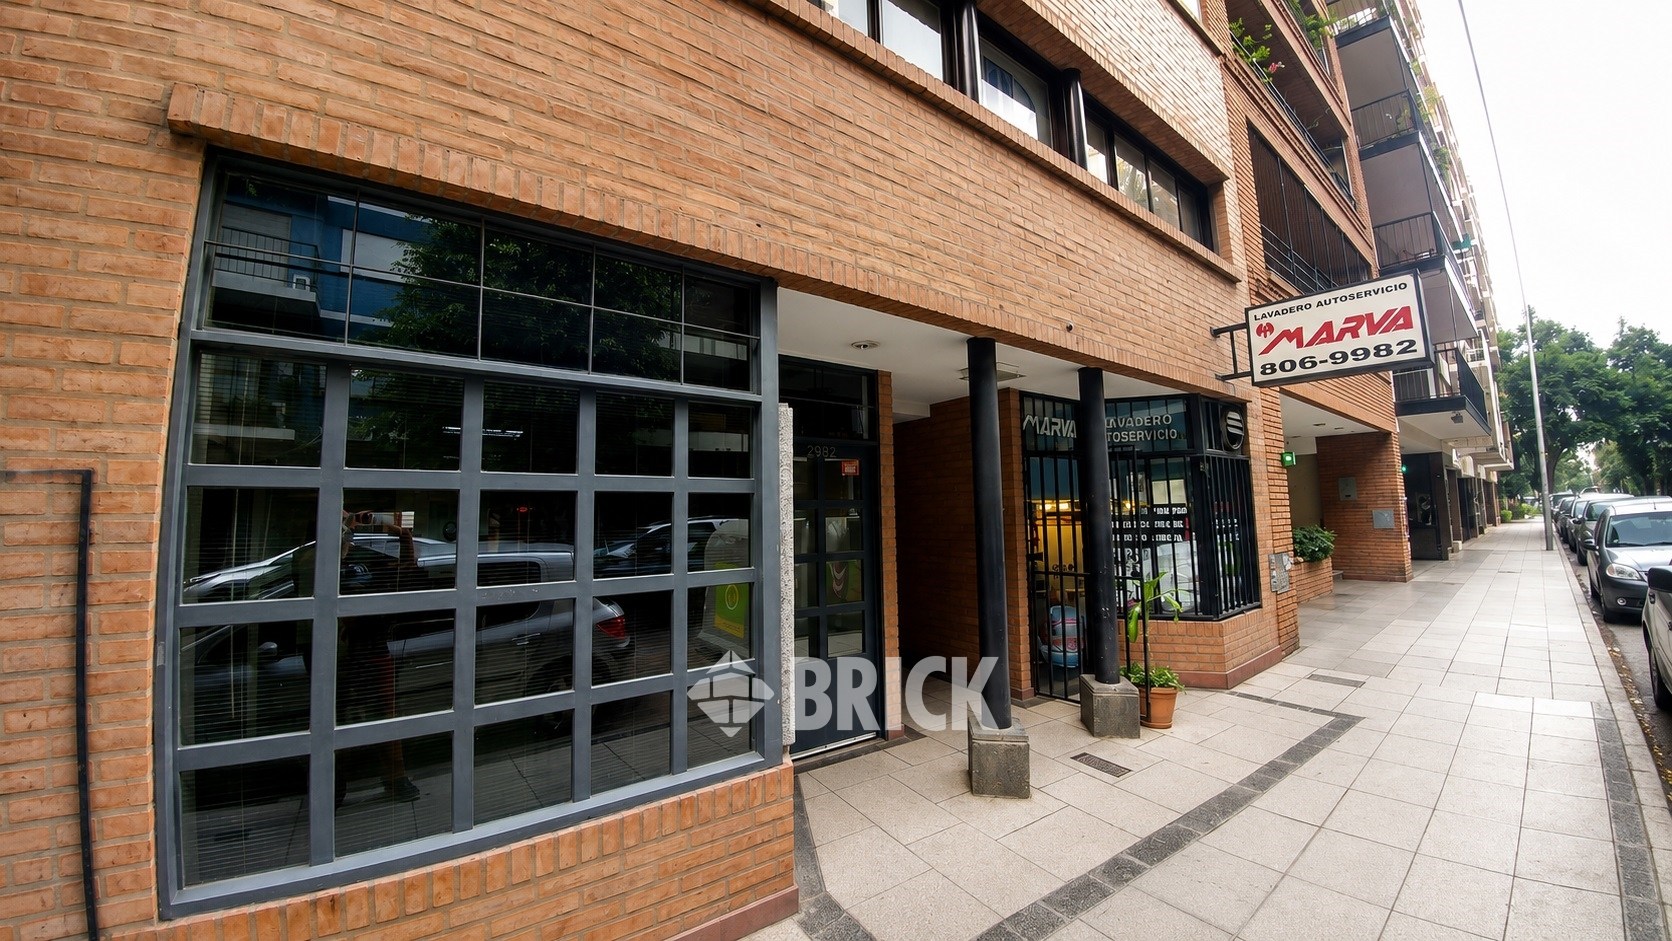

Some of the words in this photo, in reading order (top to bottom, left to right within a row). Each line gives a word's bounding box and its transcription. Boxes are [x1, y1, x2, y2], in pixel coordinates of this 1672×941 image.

[1254, 303, 1312, 321] LAVADERO
[1316, 282, 1408, 307] AUTOSERVICIO
[1259, 306, 1414, 356] MARVA
[1260, 339, 1418, 376] 806-9982
[1022, 414, 1077, 438] MARVA
[1106, 428, 1178, 442] TOSERVICIO
[807, 445, 837, 458] 2982
